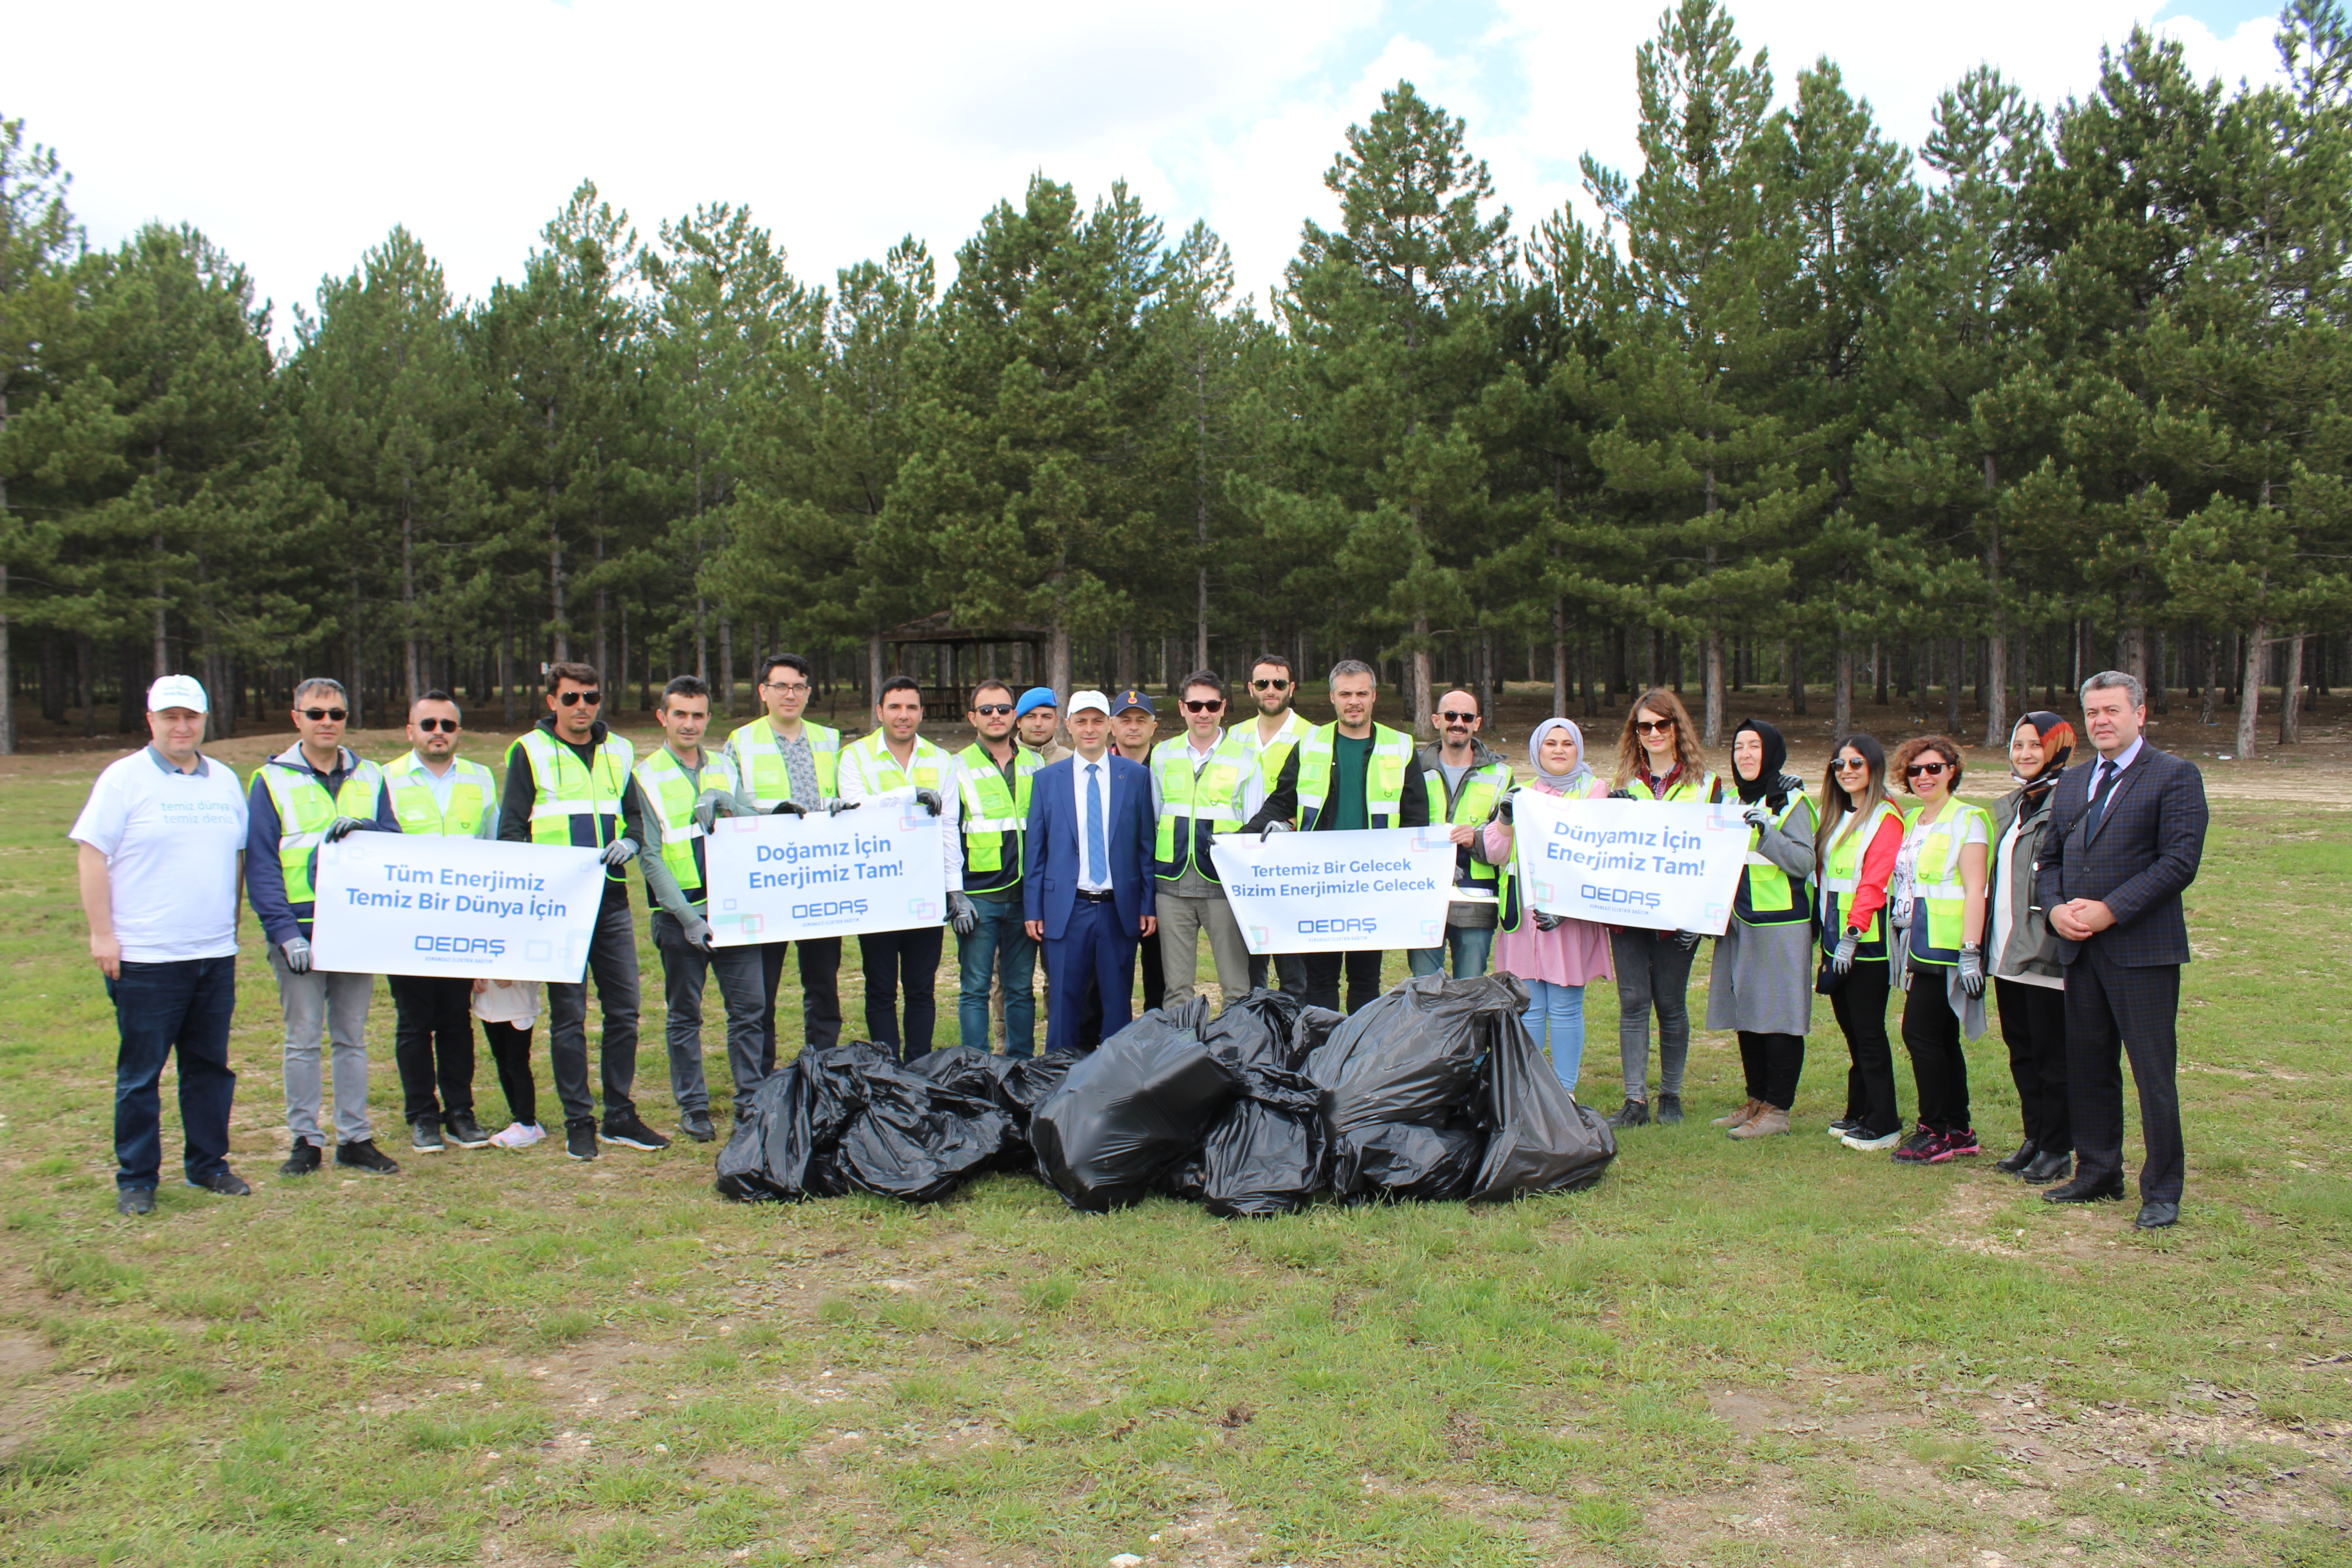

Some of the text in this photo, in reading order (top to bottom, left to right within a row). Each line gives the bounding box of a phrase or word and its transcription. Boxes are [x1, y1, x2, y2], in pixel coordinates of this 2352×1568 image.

[162, 800, 229, 812] temiz dünya
[164, 813, 233, 824] temiz deniz
[757, 833, 891, 864] Doğamız İçin
[1554, 822, 1701, 853] Dünyamız İçin
[1251, 858, 1411, 877] Tertemiz Bir Gelecek
[1547, 842, 1705, 876] Enerjimiz Tam!
[384, 865, 544, 892] Tüm Enerjimiz
[750, 860, 902, 889] Enerjimiz Tam!
[1232, 878, 1435, 897] Bizim Enerjimizle Gelecek
[1581, 884, 1660, 910] OEDAŞ
[346, 888, 565, 921] Temiz Bir Dünya İçin
[792, 899, 867, 919] OEDAŞ
[1298, 918, 1377, 933] OEDAŞ
[415, 936, 505, 957] OEDAŞ
